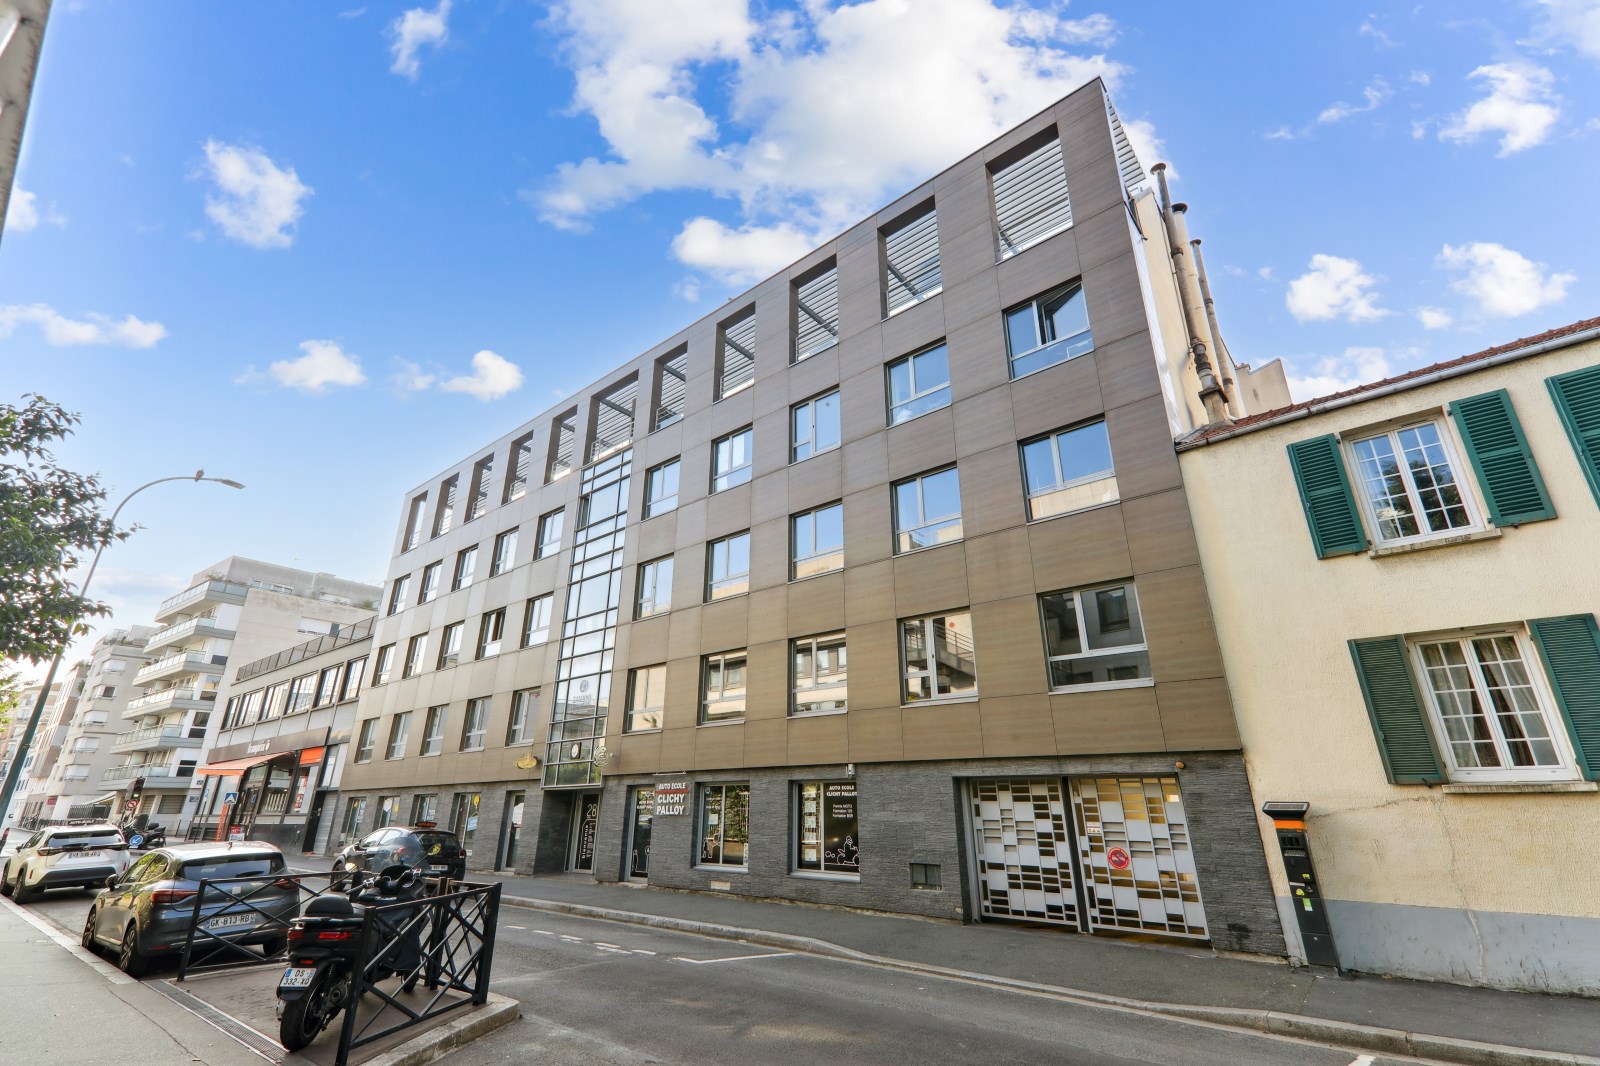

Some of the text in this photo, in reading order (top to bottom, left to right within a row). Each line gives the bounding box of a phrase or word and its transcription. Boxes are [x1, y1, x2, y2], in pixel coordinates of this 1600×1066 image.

[671, 782, 686, 790] ECOLE
[658, 794, 684, 803] CLICHY
[587, 804, 597, 816] 28
[656, 806, 684, 815] PALLOY
[211, 915, 249, 926] GK-813-RB
